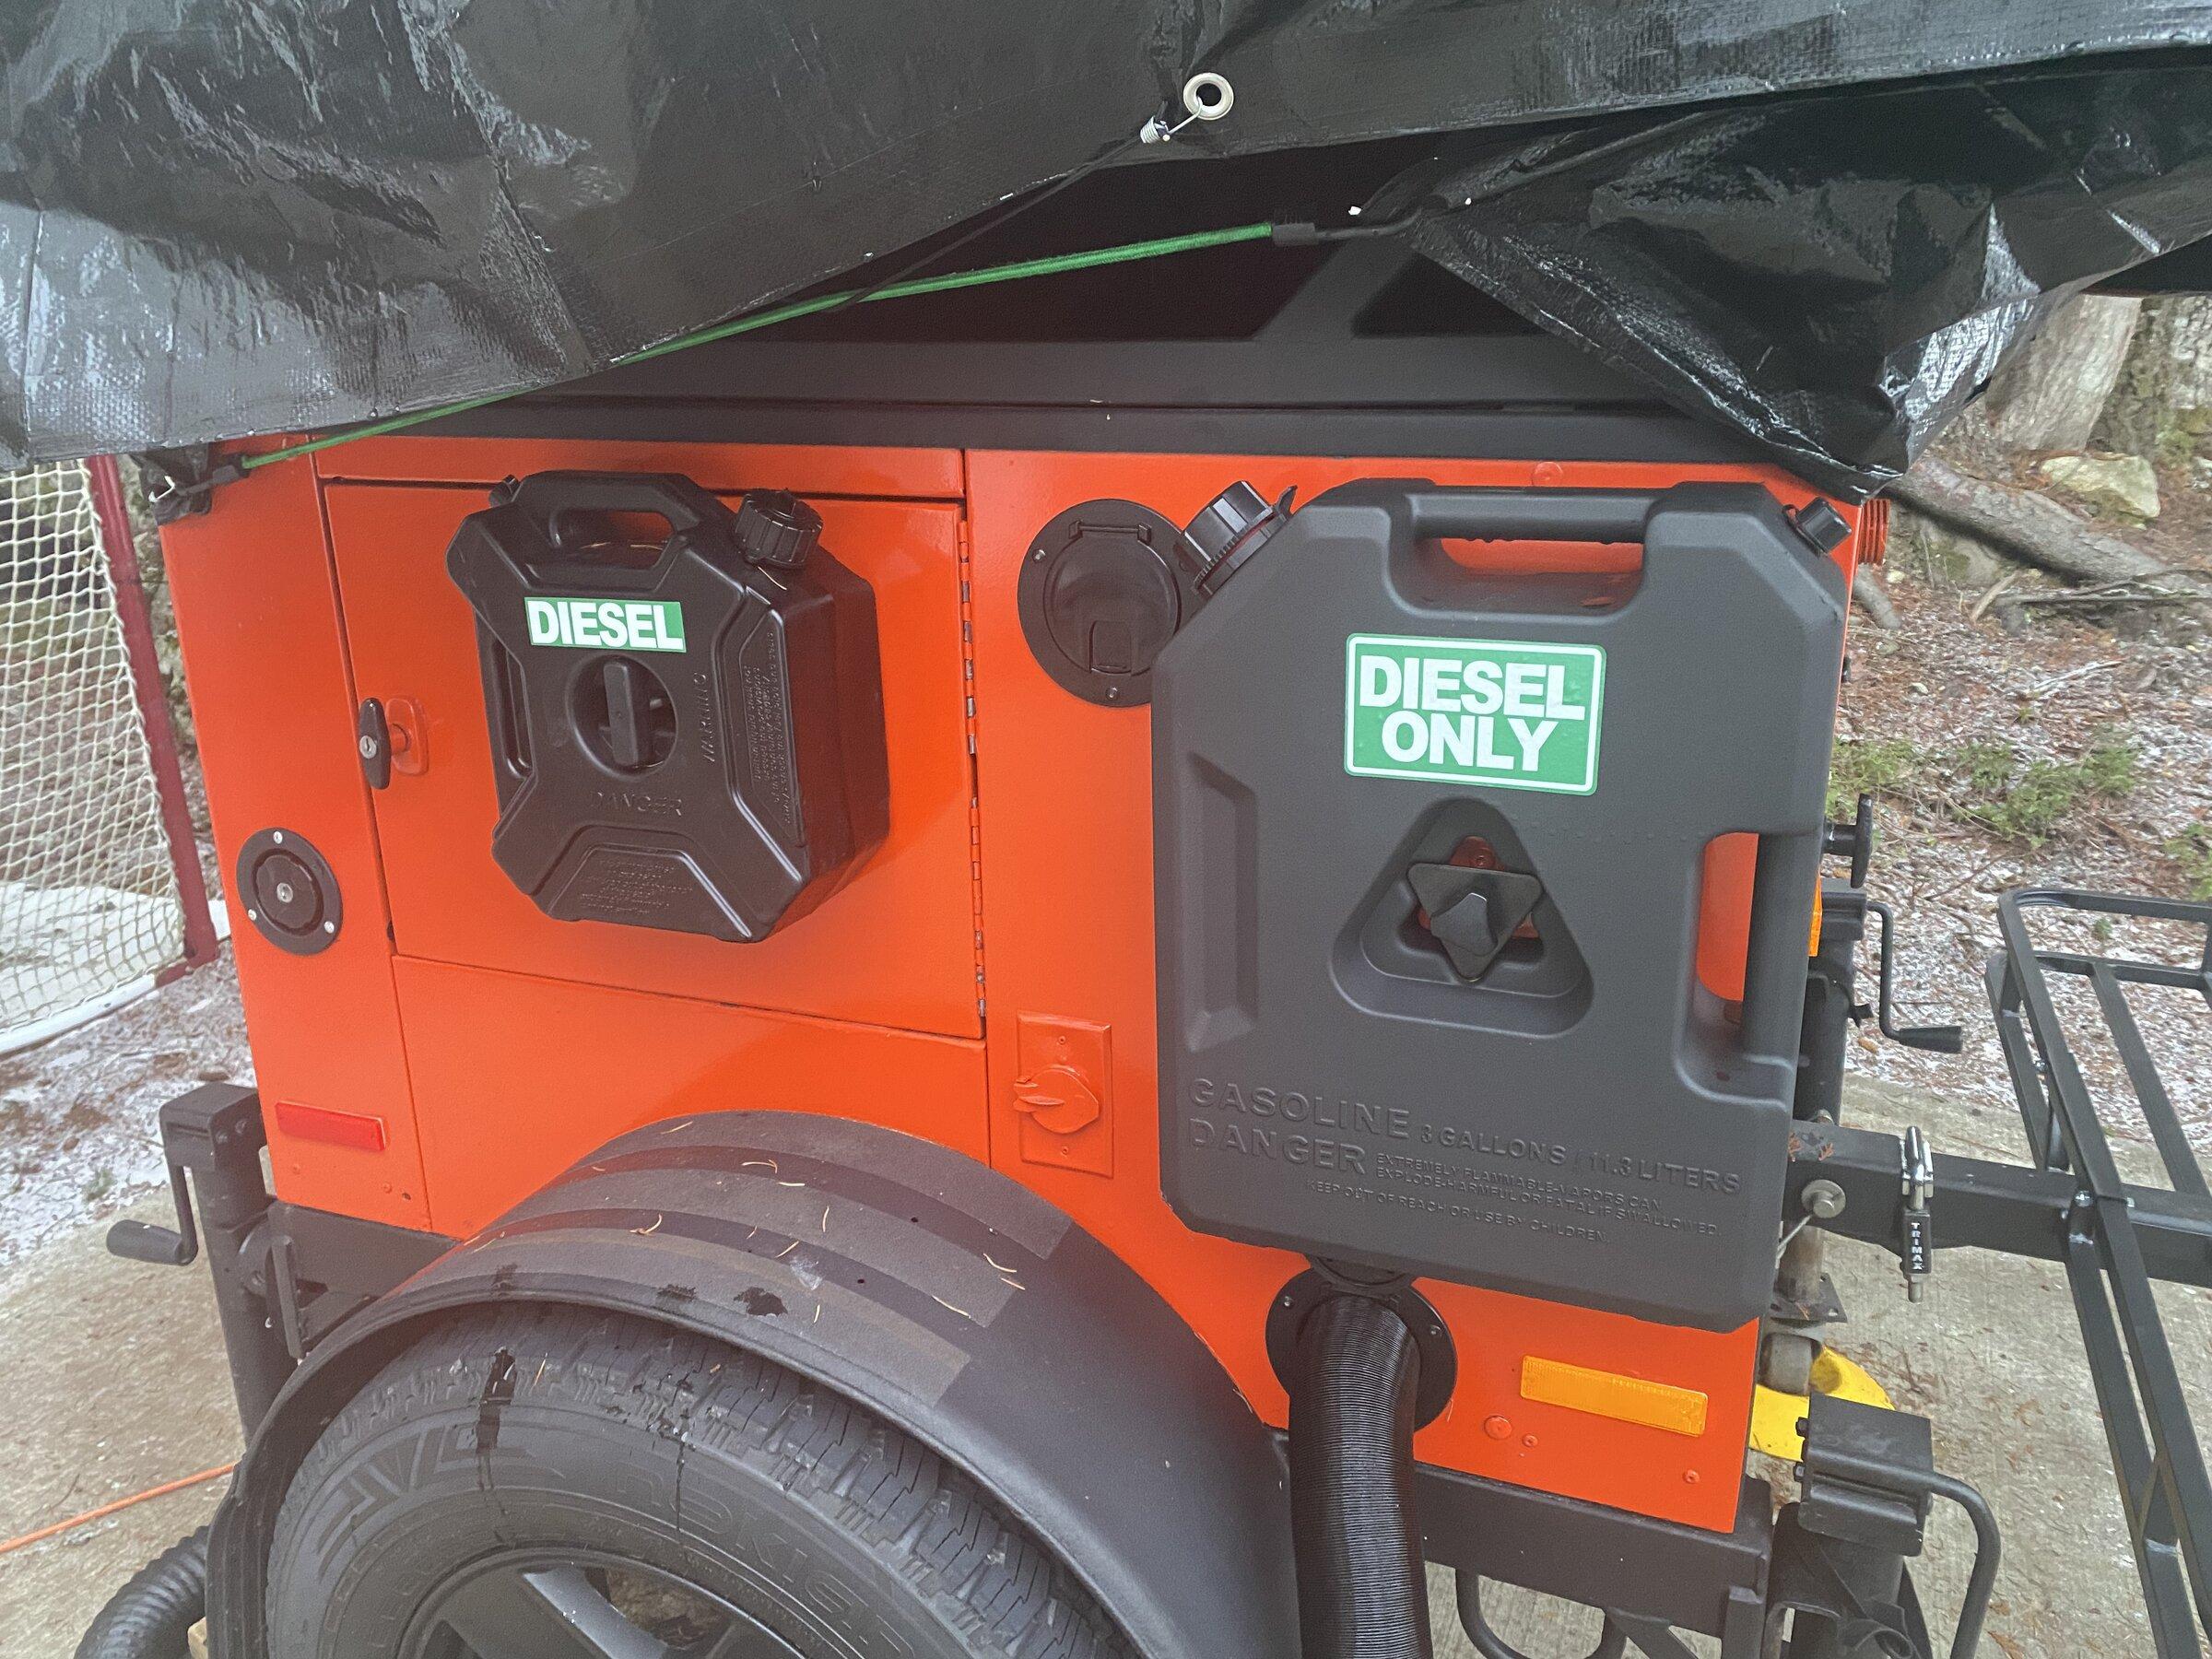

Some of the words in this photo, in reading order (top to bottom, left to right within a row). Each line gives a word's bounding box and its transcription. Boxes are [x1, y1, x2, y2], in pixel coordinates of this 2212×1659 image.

[527, 600, 684, 650] DIESEL
[1359, 654, 1586, 721] DIESEL
[1382, 710, 1559, 772] ONLY
[1189, 1077, 1410, 1140] GASOLINE
[1420, 1124, 1433, 1144] 3
[1439, 1125, 1568, 1167] GALLONS
[1638, 1159, 1741, 1195] LITERS
[1189, 1117, 1367, 1175] DANGER
[1376, 1153, 1461, 1177] EXTREMELY
[1628, 1195, 1662, 1212] CAN
[1398, 1194, 1447, 1213] REACH
[1449, 1205, 1471, 1218] OR
[1520, 1191, 1542, 1206] OR
[1546, 1194, 1596, 1216] FATAL
[1911, 1222, 1924, 1270] TRIMAX
